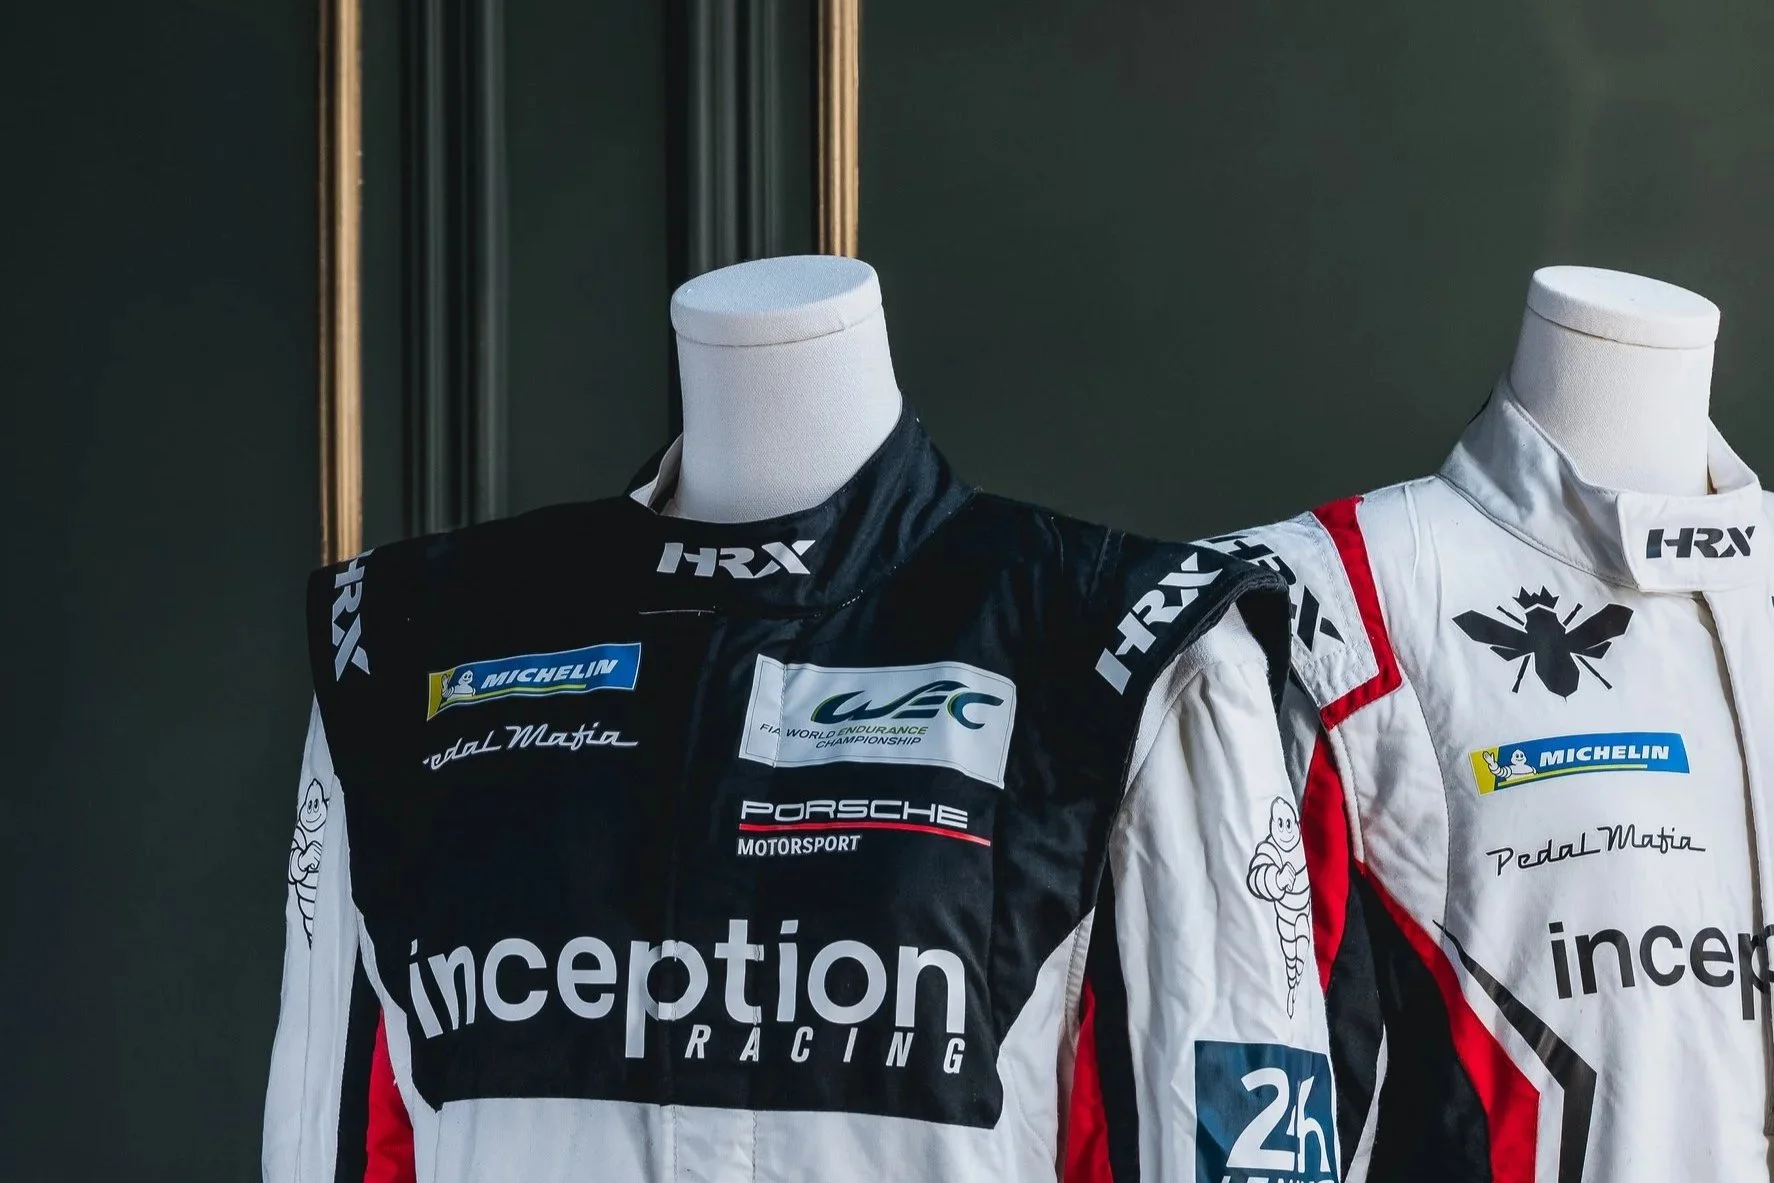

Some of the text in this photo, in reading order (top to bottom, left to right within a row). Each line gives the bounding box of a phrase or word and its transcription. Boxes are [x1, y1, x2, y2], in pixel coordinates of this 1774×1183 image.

[656, 539, 816, 579] HRX
[1646, 525, 1756, 559] HRX
[332, 548, 371, 682] HRX
[1095, 552, 1224, 695] HRX
[480, 658, 619, 689] MICHELIN
[810, 680, 1004, 730] WEC
[422, 721, 639, 770] edal Mafia
[759, 723, 929, 740] FIA WORLD ENDURANCE
[815, 735, 922, 749] CHAMPIONSHIP
[1538, 744, 1670, 768] MICHELIN
[740, 800, 969, 830] PORSCHE
[737, 834, 861, 856] MOTORSPORT
[1485, 823, 1707, 877] Pedal Mafia
[409, 919, 967, 1059] inception
[684, 1024, 967, 1075] RACING
